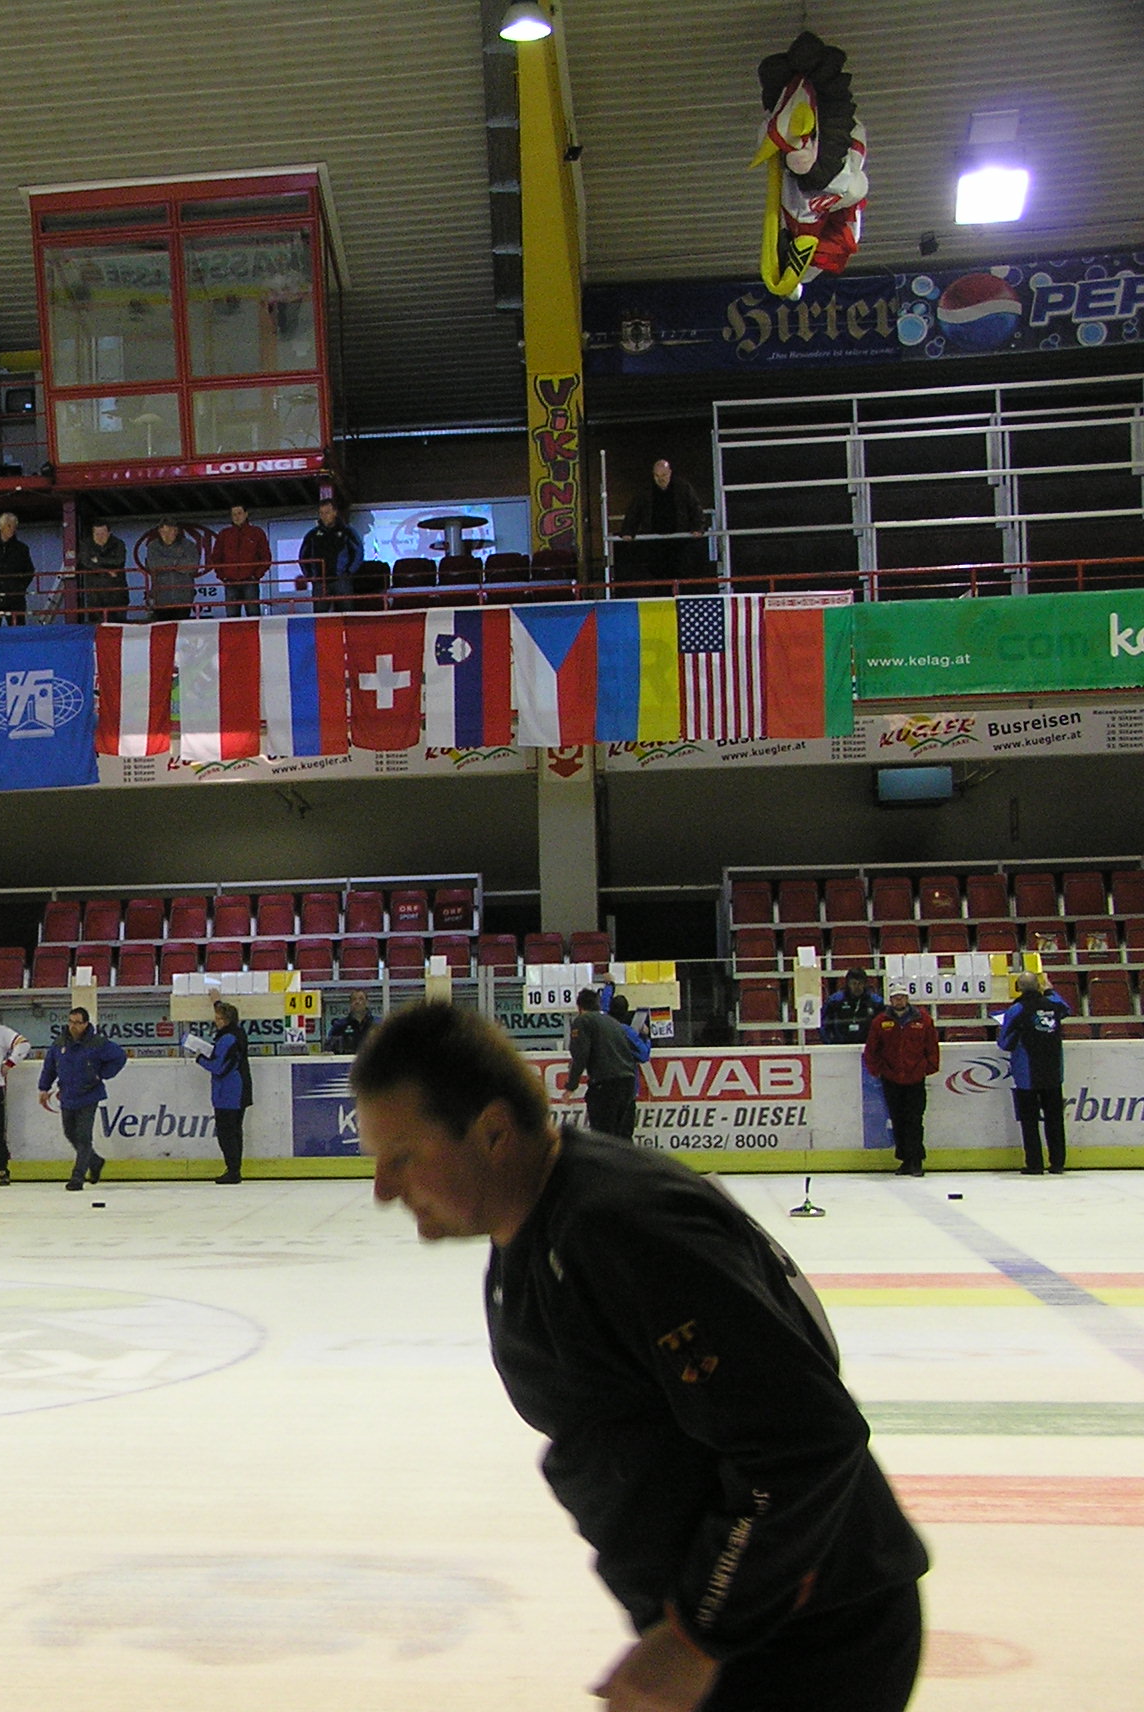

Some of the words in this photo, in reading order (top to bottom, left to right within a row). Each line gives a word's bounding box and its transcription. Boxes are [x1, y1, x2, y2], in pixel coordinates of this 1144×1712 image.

[722, 292, 902, 361] Hirter
[206, 458, 308, 475] LOUNGE
[867, 653, 971, 668] www.kelag.at
[988, 711, 1082, 738] Busreisen
[992, 730, 1082, 751] www.kuegler.at
[721, 741, 806, 761] www.kuegler.at
[272, 755, 354, 775] www.kuegler.at
[733, 1105, 808, 1127] DIESEL
[735, 1134, 778, 1148] 8000
